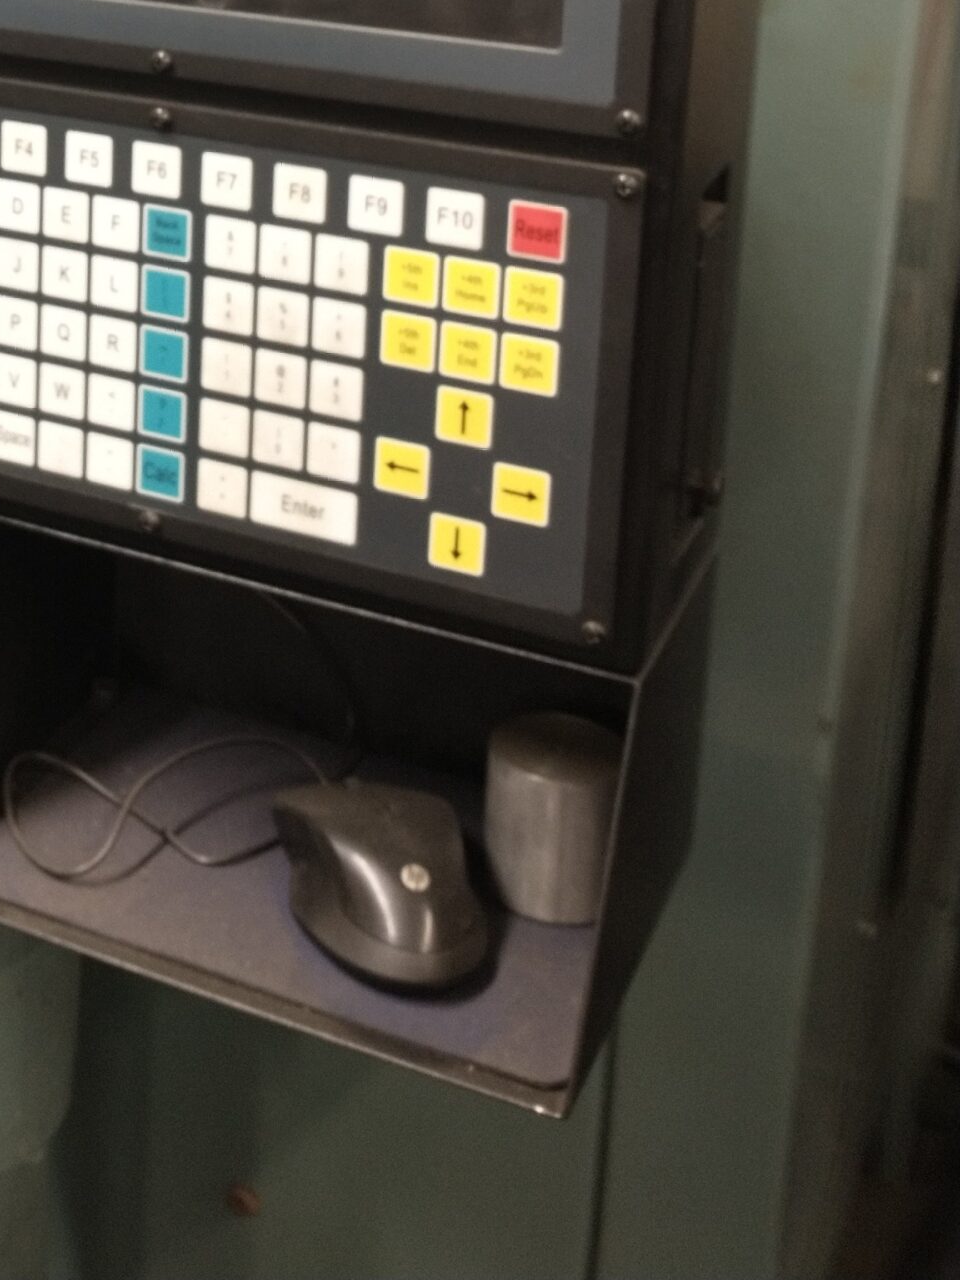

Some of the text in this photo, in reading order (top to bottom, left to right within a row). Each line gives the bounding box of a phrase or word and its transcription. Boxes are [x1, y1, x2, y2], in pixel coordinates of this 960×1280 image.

[14, 137, 34, 157] F4
[79, 148, 100, 169] F5
[146, 159, 168, 180] F6
[215, 170, 238, 190] F7
[288, 182, 312, 204] F8
[11, 196, 25, 216] D
[60, 204, 72, 225] E
[364, 194, 389, 217] F9
[110, 214, 121, 230] F
[436, 206, 475, 231] F10
[514, 217, 559, 245] Reset
[59, 266, 70, 283] K
[9, 312, 22, 330] P
[56, 322, 71, 343] Q
[106, 333, 119, 352] R
[54, 382, 71, 401] W
[280, 492, 326, 524] Enter
